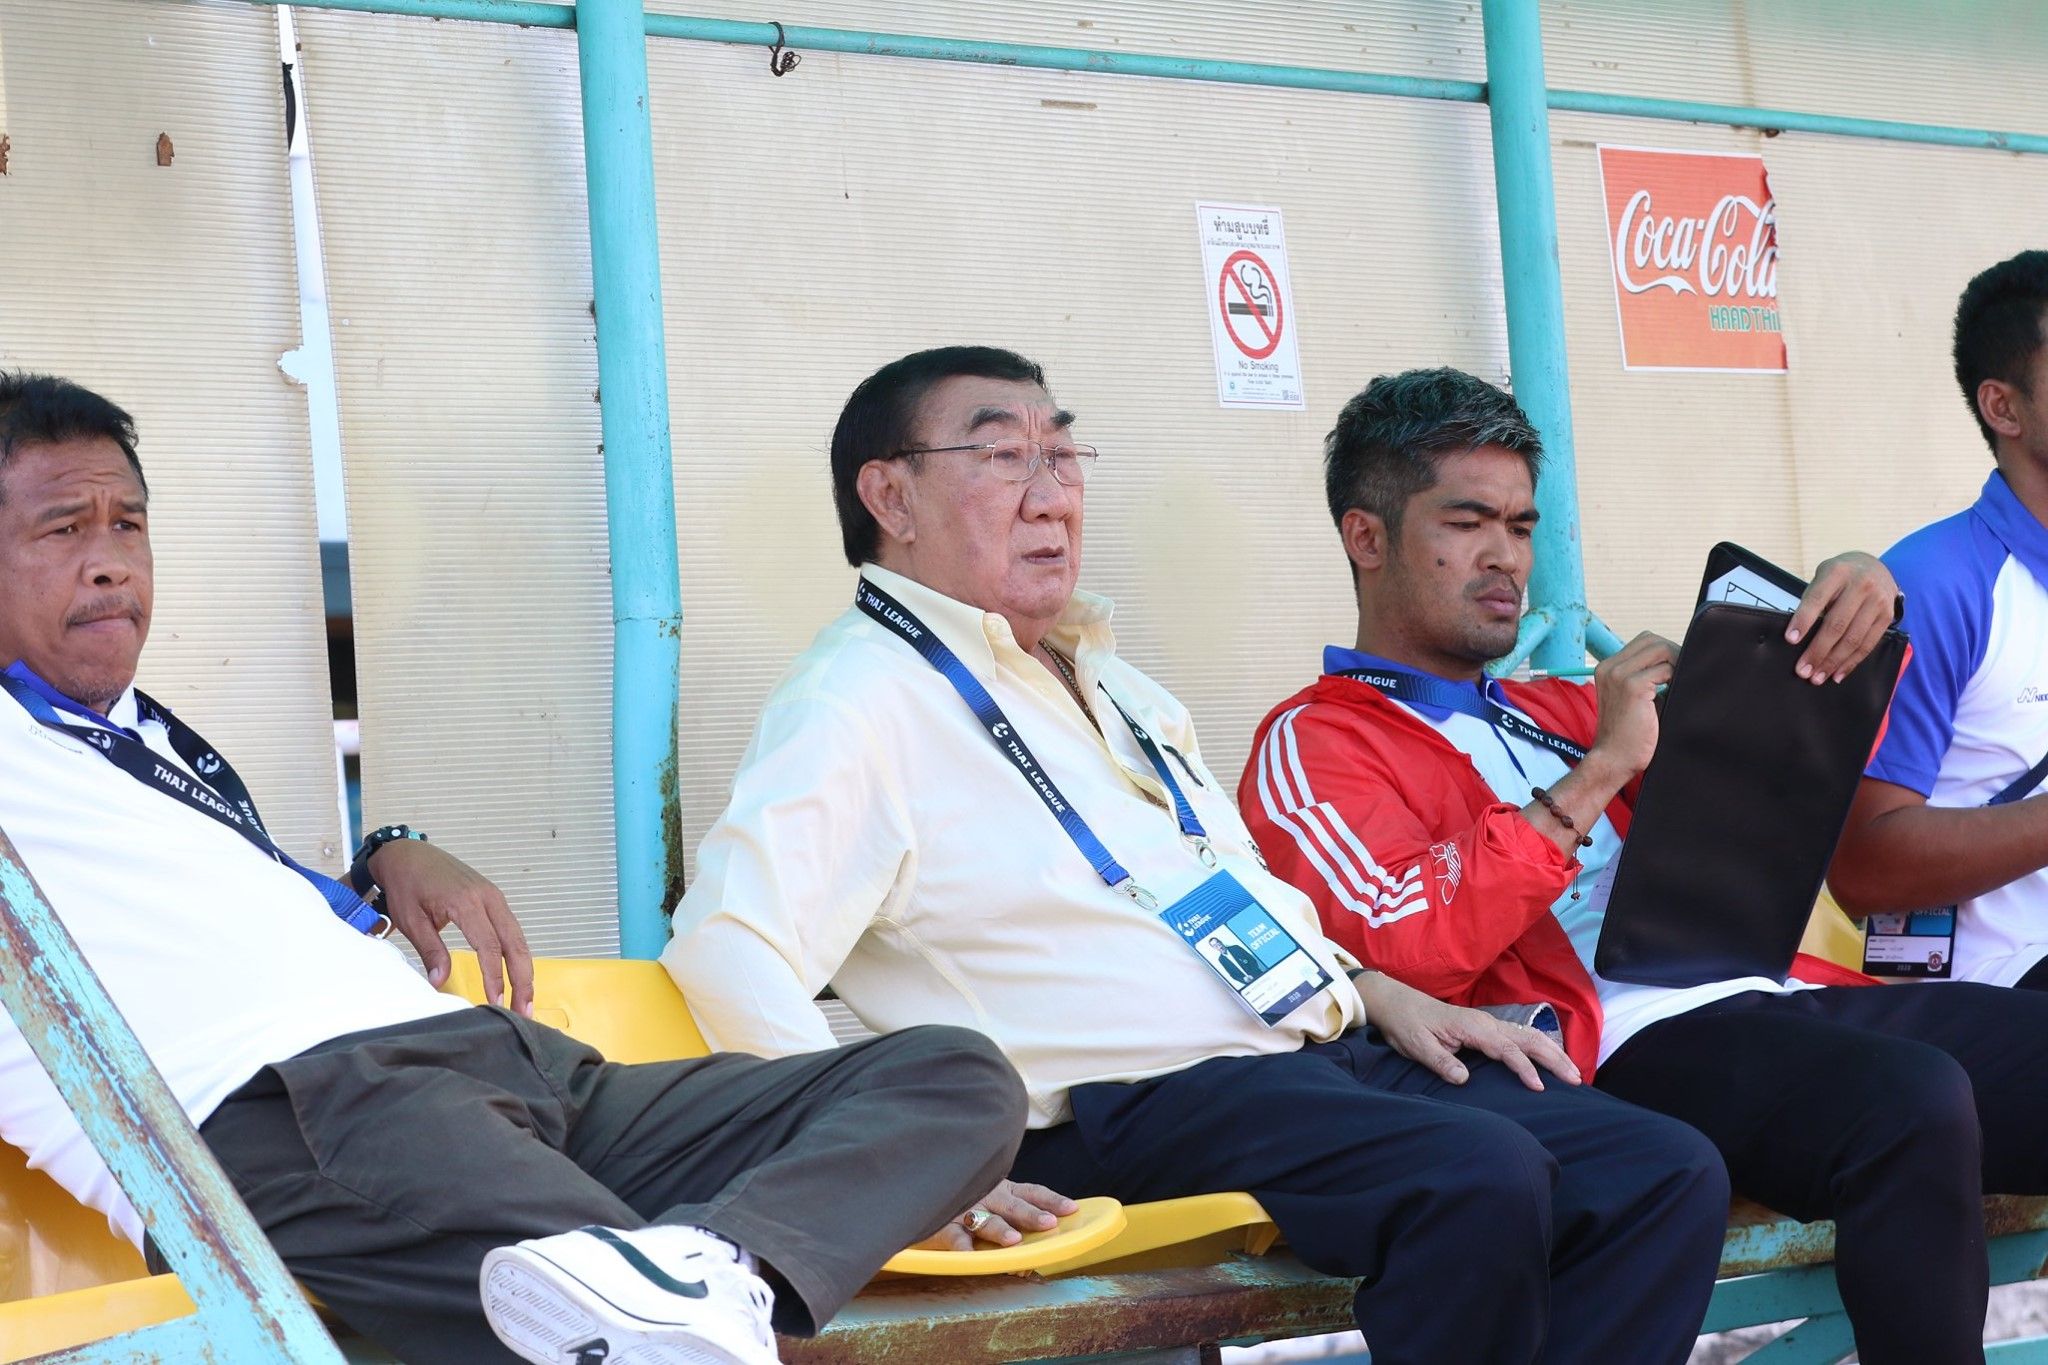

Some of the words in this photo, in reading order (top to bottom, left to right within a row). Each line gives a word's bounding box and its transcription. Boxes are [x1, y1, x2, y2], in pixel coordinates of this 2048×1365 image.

[1751, 306, 1781, 332] THI
[1239, 361, 1248, 370] No
[1250, 361, 1279, 373] Smoking
[865, 592, 883, 612] THAI
[884, 606, 921, 639] LEAGUE
[1518, 724, 1544, 742] THAI
[1008, 740, 1032, 770] THAI
[1030, 771, 1065, 812] LEAGUE
[154, 764, 189, 793] THAI
[191, 787, 243, 825] LEAGUE
[1247, 922, 1267, 938] TEAM
